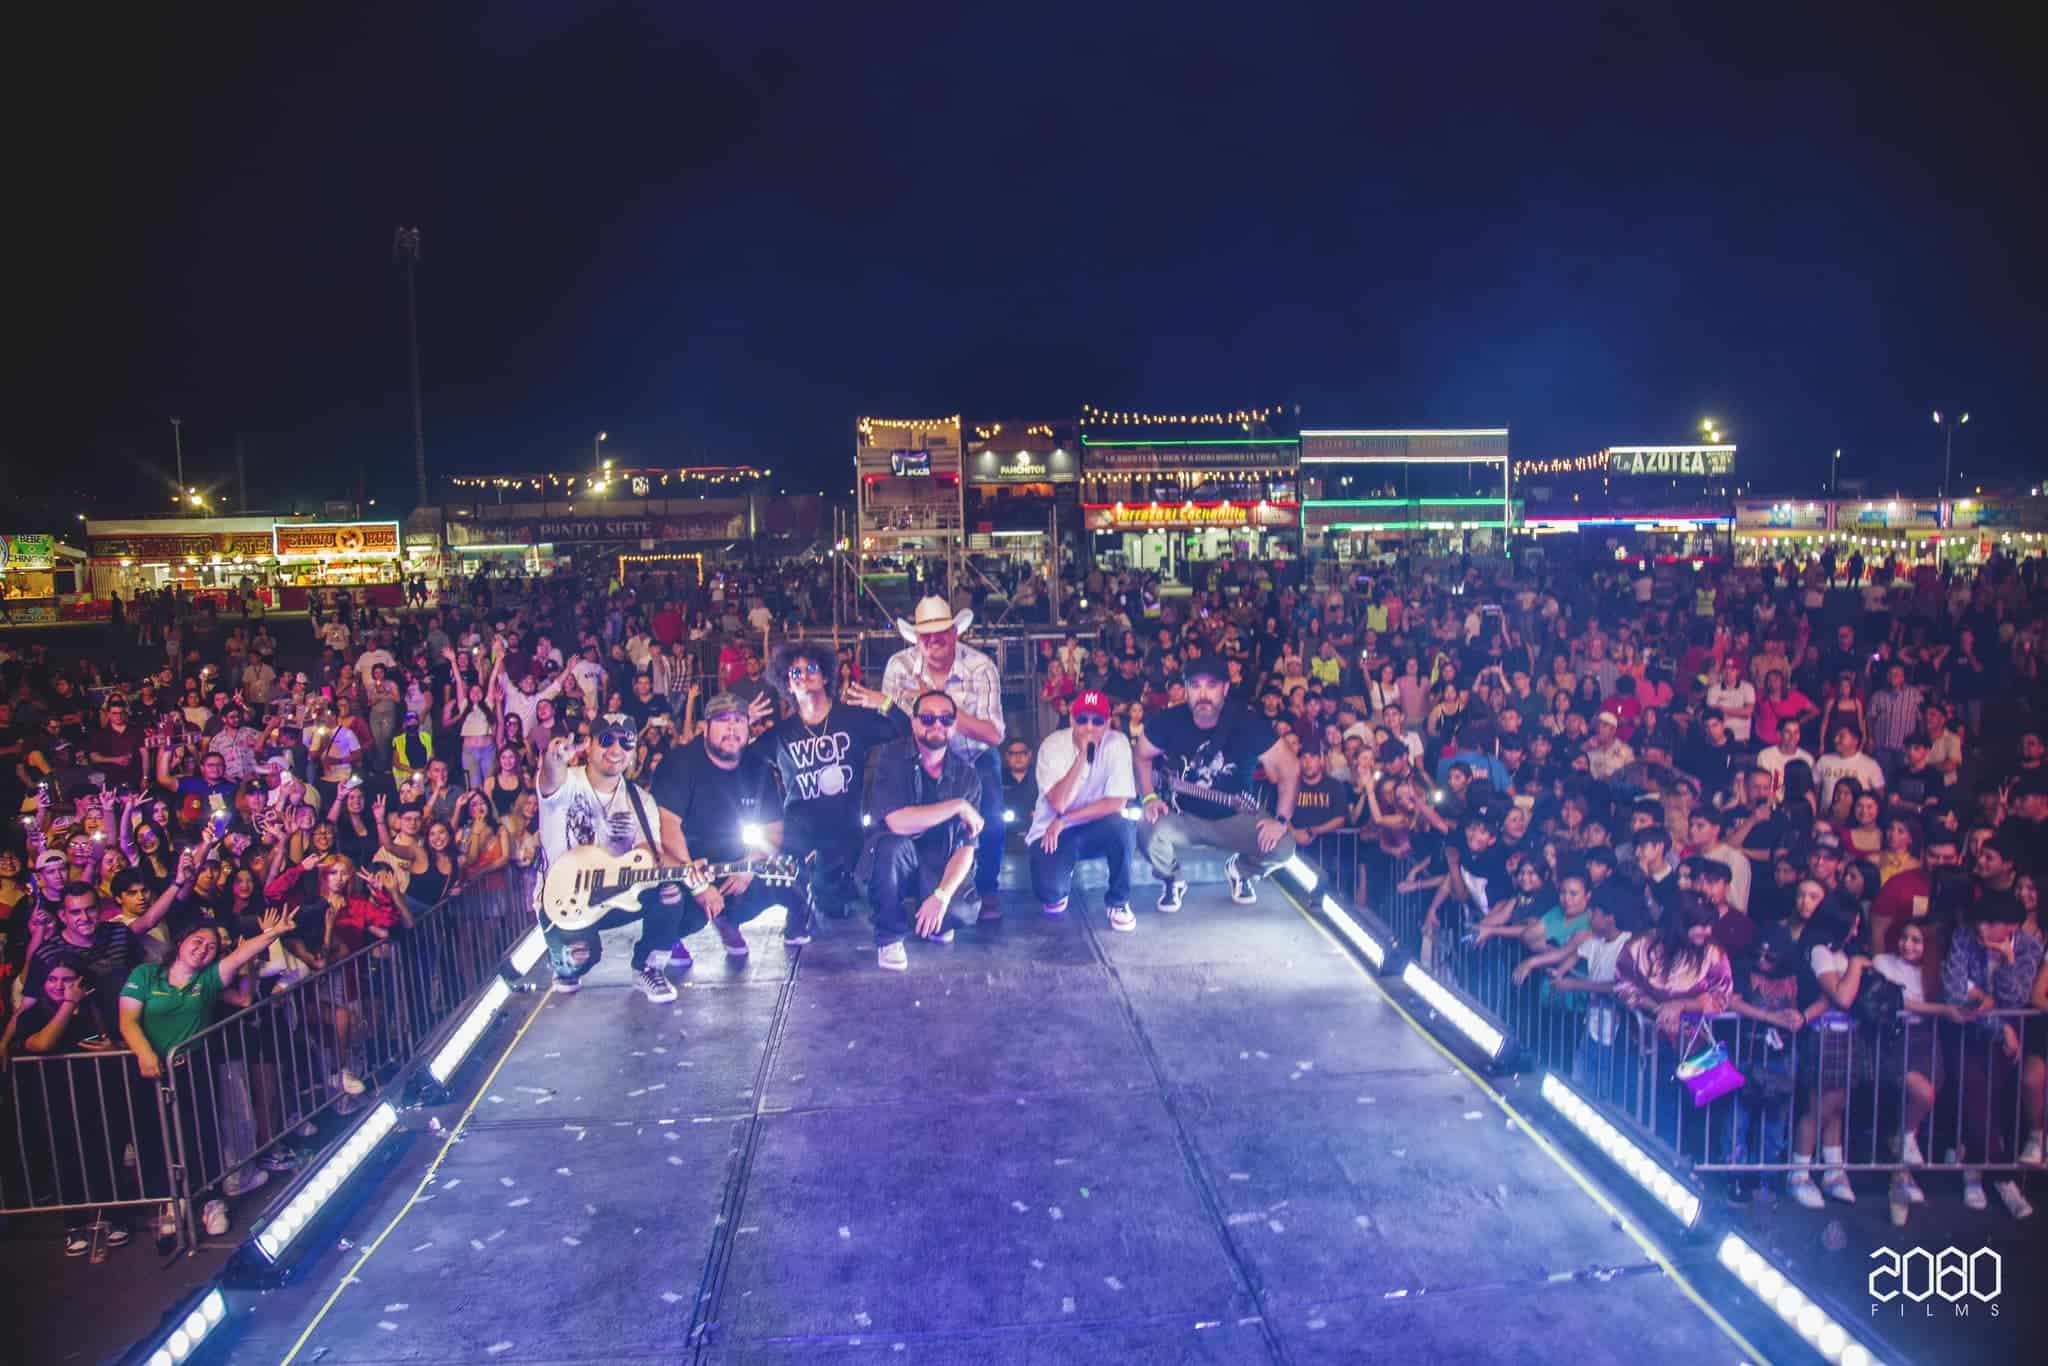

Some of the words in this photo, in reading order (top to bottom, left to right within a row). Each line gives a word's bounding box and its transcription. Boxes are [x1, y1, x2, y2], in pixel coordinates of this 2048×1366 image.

[1631, 451, 1705, 475] AZOTEA
[788, 731, 850, 769] WOP
[795, 764, 853, 801] WOP
